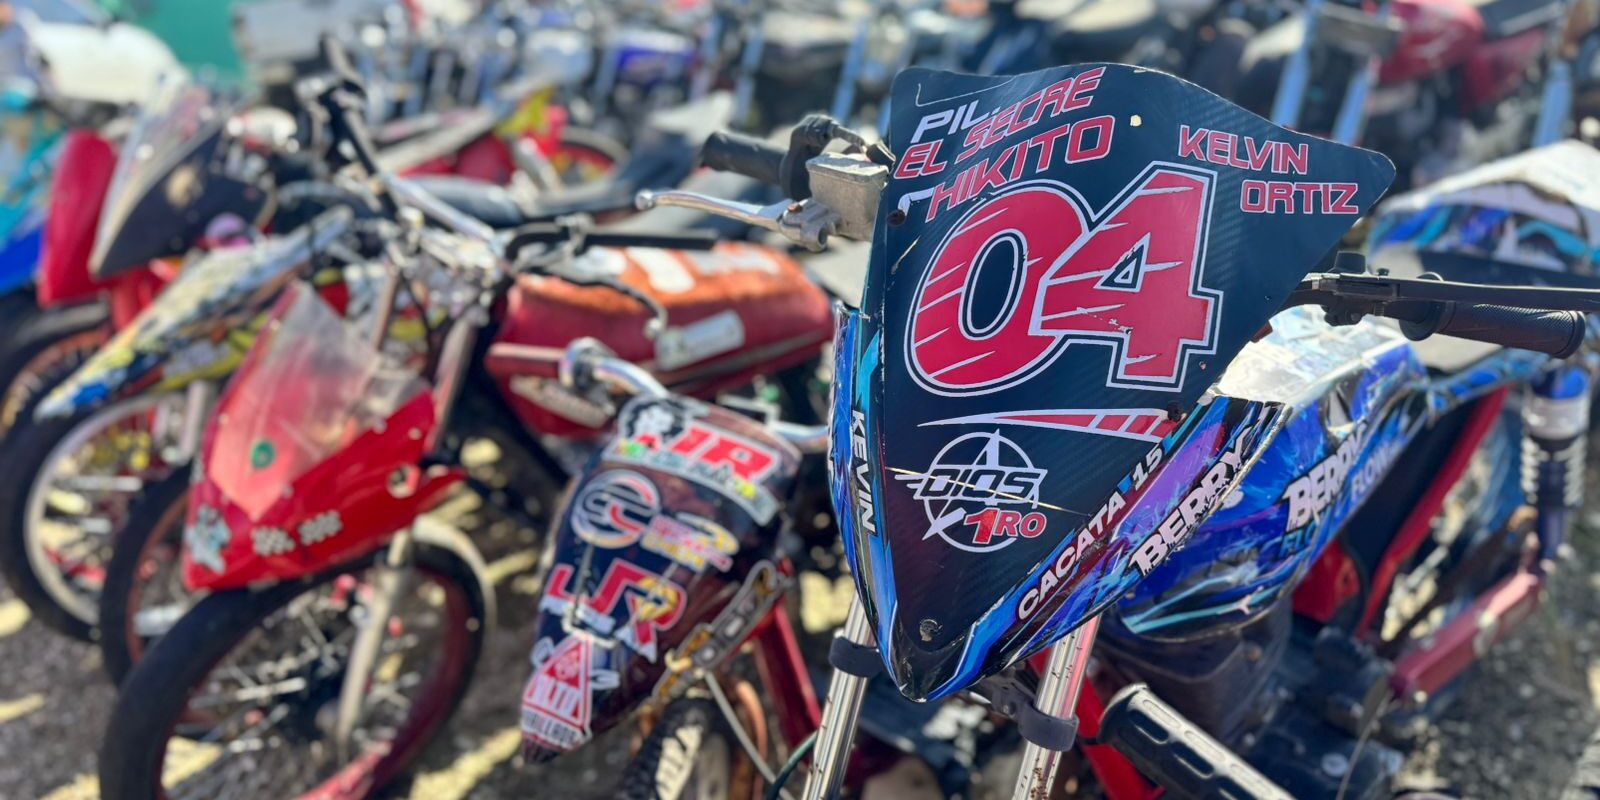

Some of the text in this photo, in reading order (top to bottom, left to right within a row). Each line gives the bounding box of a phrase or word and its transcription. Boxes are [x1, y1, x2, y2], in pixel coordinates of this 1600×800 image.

[893, 66, 1107, 179] EL SECRE
[1178, 124, 1309, 175] KELVIN
[1240, 179, 1359, 215] ORTIZ
[903, 160, 1223, 397] 04
[852, 409, 876, 534] KEVIN
[914, 464, 1048, 504] DIOS
[963, 507, 1048, 545] 1RO
[1128, 425, 1254, 577] BERRY
[1018, 446, 1164, 621] CACATA 15
